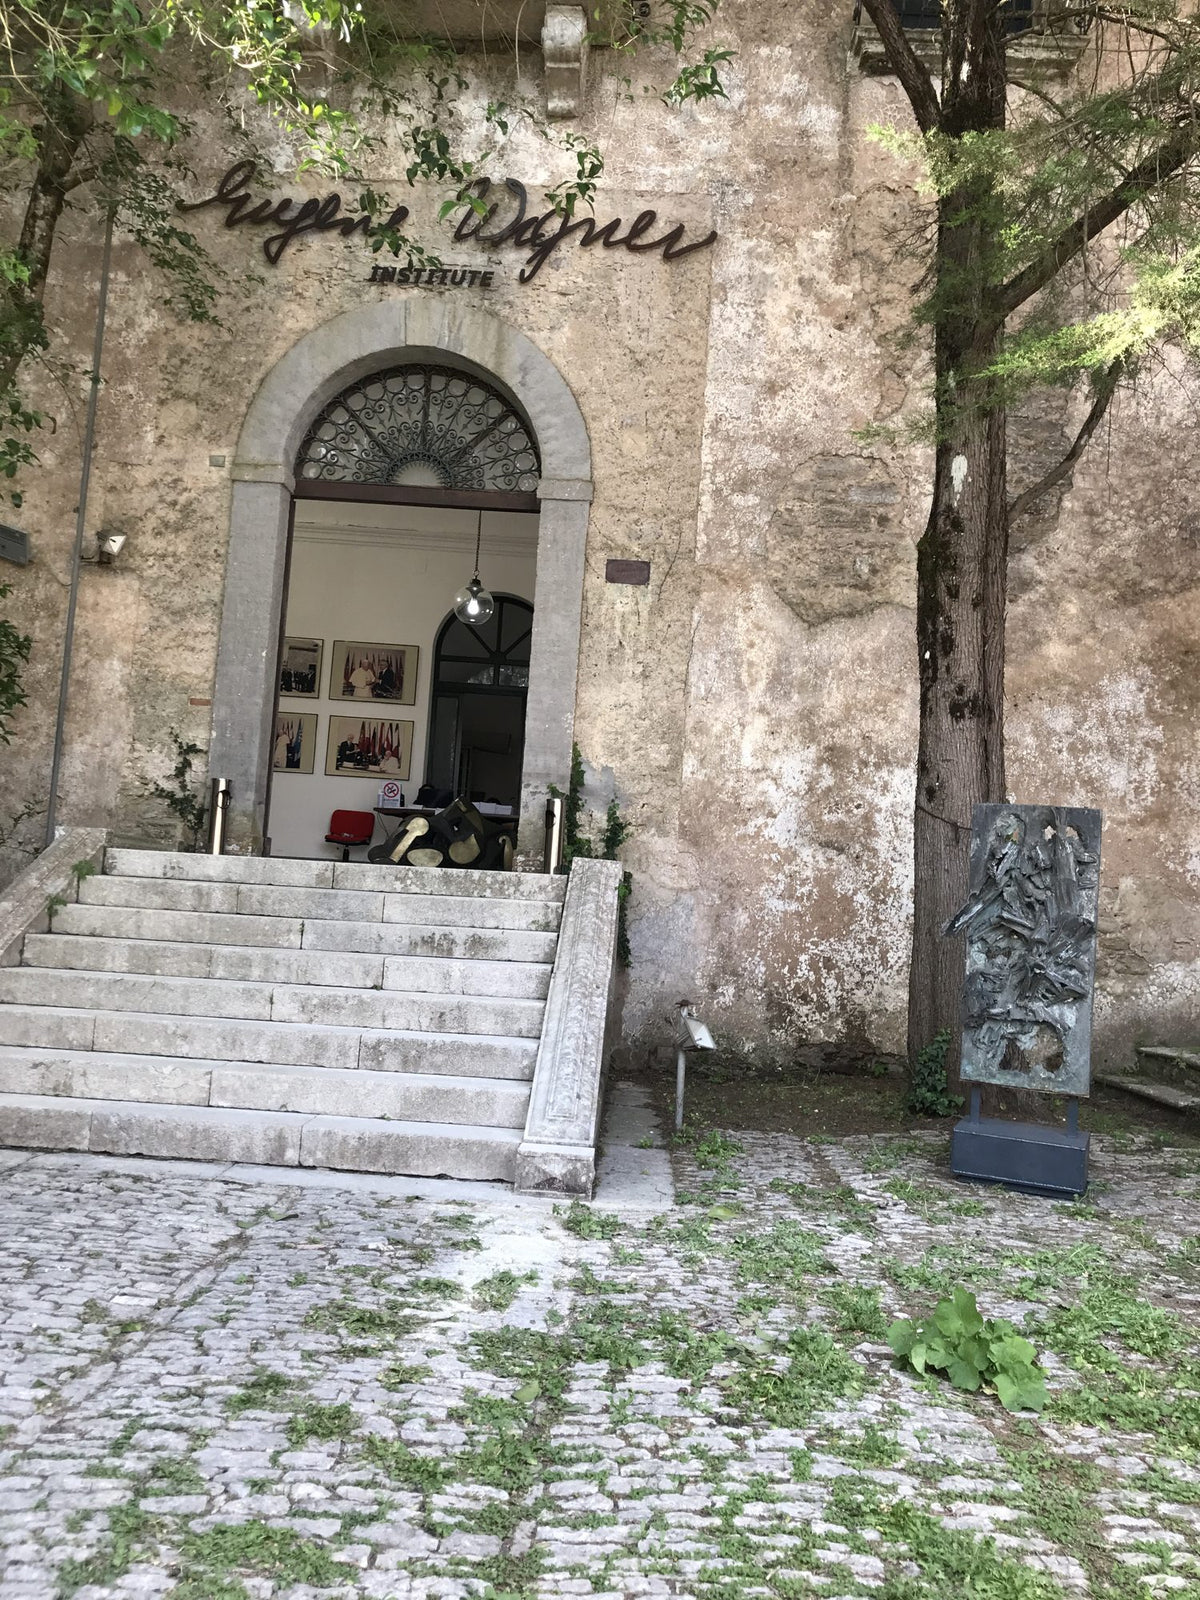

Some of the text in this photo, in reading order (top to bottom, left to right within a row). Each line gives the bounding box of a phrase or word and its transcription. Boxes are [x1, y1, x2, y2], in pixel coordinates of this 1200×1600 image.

[175, 159, 718, 284] Eugene Wagner
[367, 265, 495, 288] INSTITUTE
